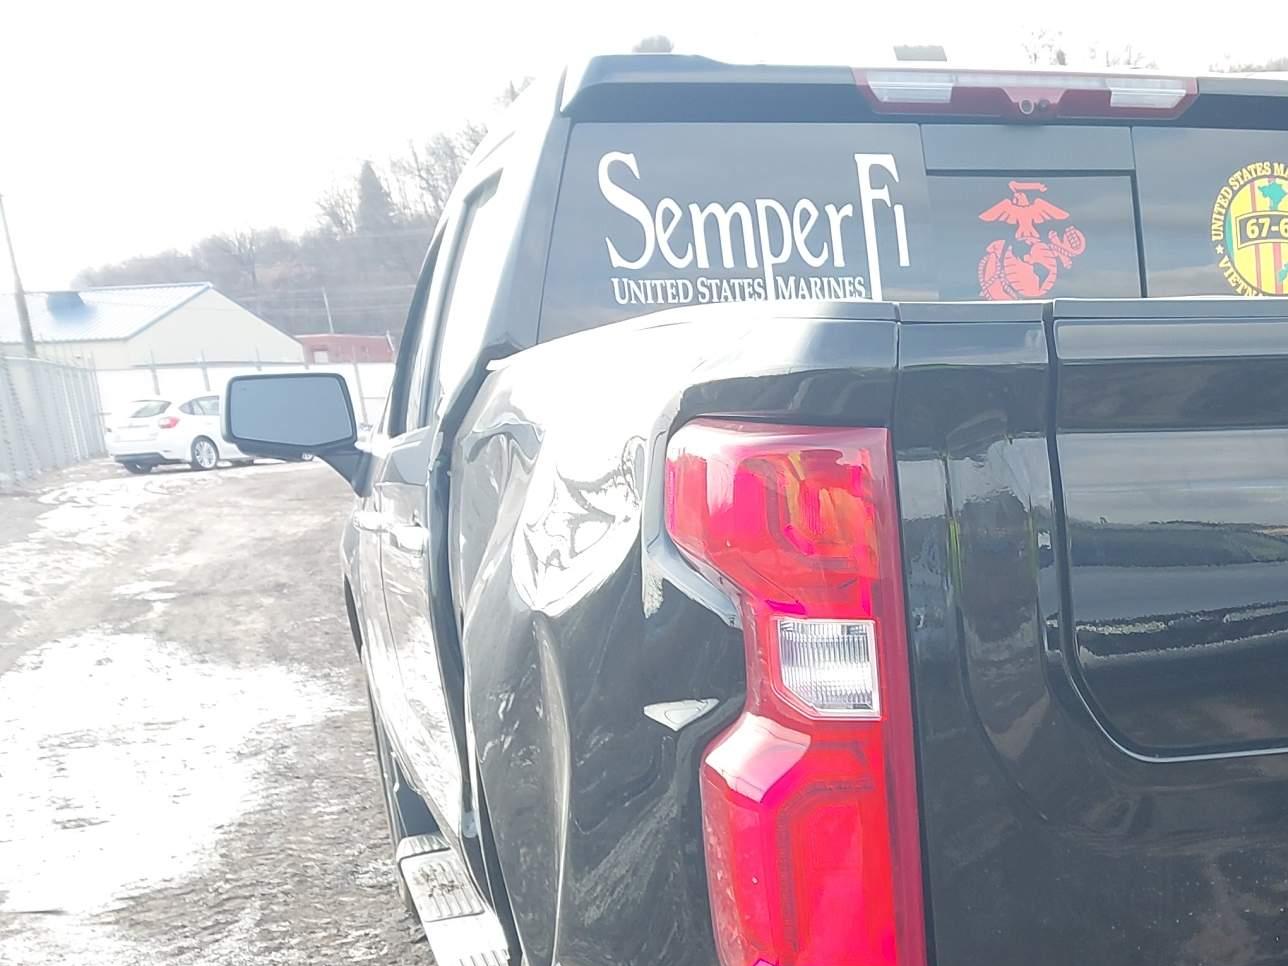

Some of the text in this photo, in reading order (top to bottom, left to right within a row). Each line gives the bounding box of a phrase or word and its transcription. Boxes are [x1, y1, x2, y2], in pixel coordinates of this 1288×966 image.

[1212, 186, 1233, 241] UNITED
[1230, 161, 1272, 190] STATES
[611, 276, 866, 304] UNITED STATES MARINES
